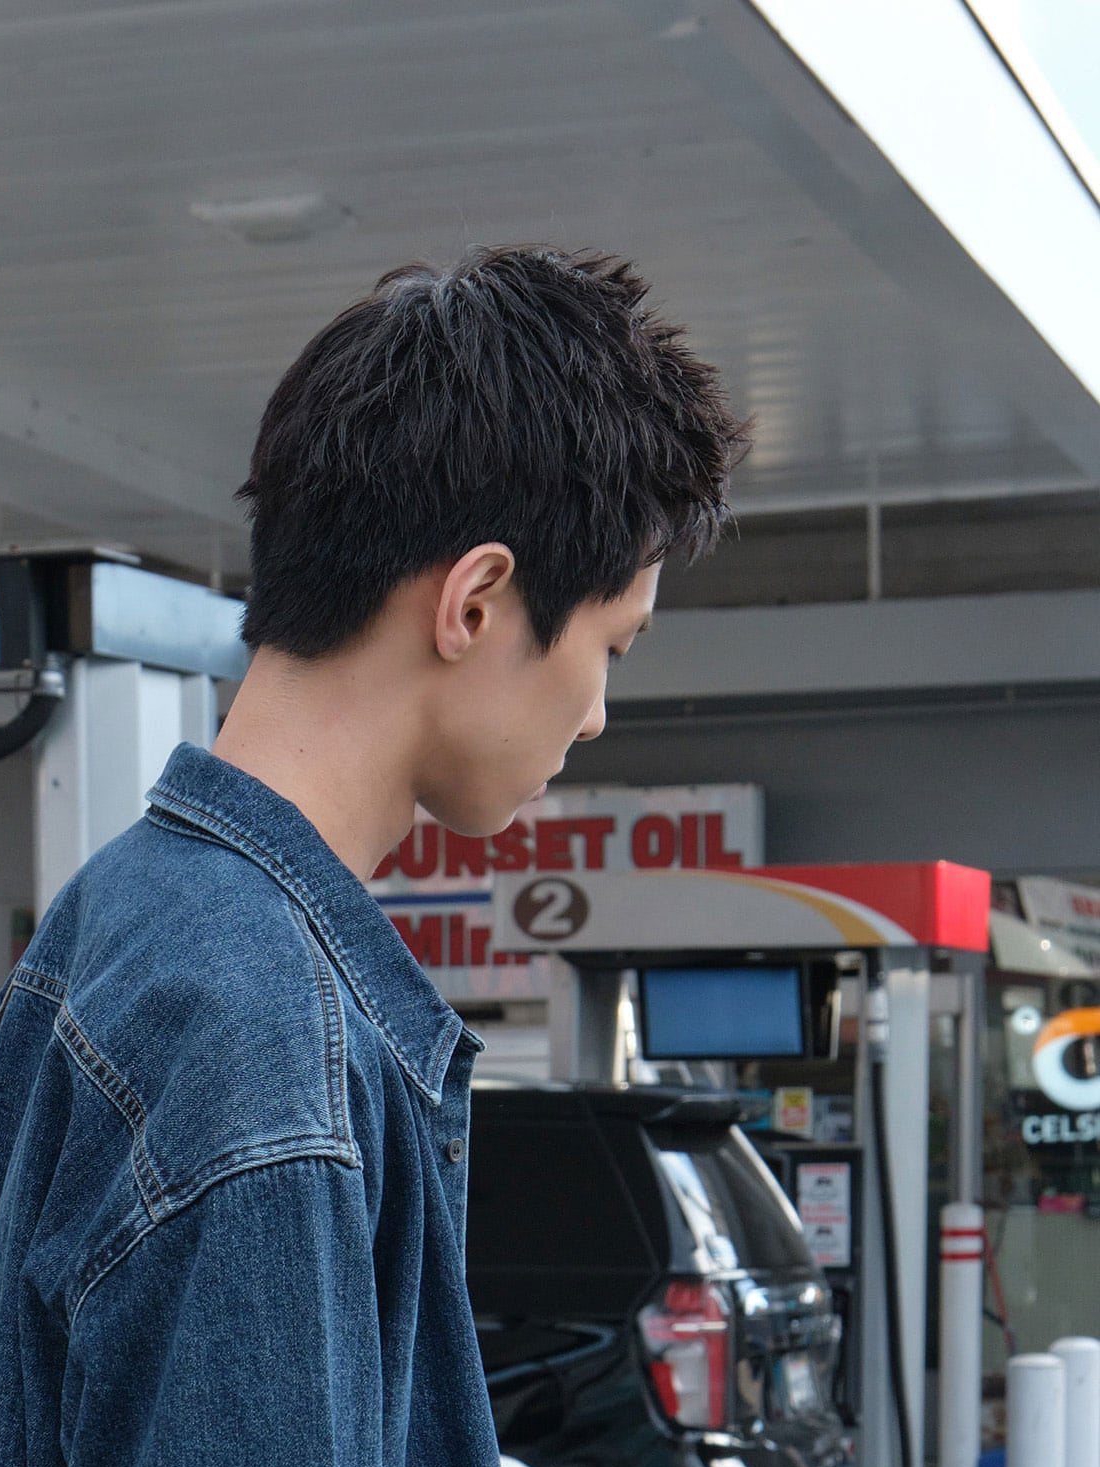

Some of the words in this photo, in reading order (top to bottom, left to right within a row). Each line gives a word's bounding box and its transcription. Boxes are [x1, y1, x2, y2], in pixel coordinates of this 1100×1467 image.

[631, 813, 742, 869] OIL
[528, 881, 576, 934] 2
[389, 913, 530, 967] Min
